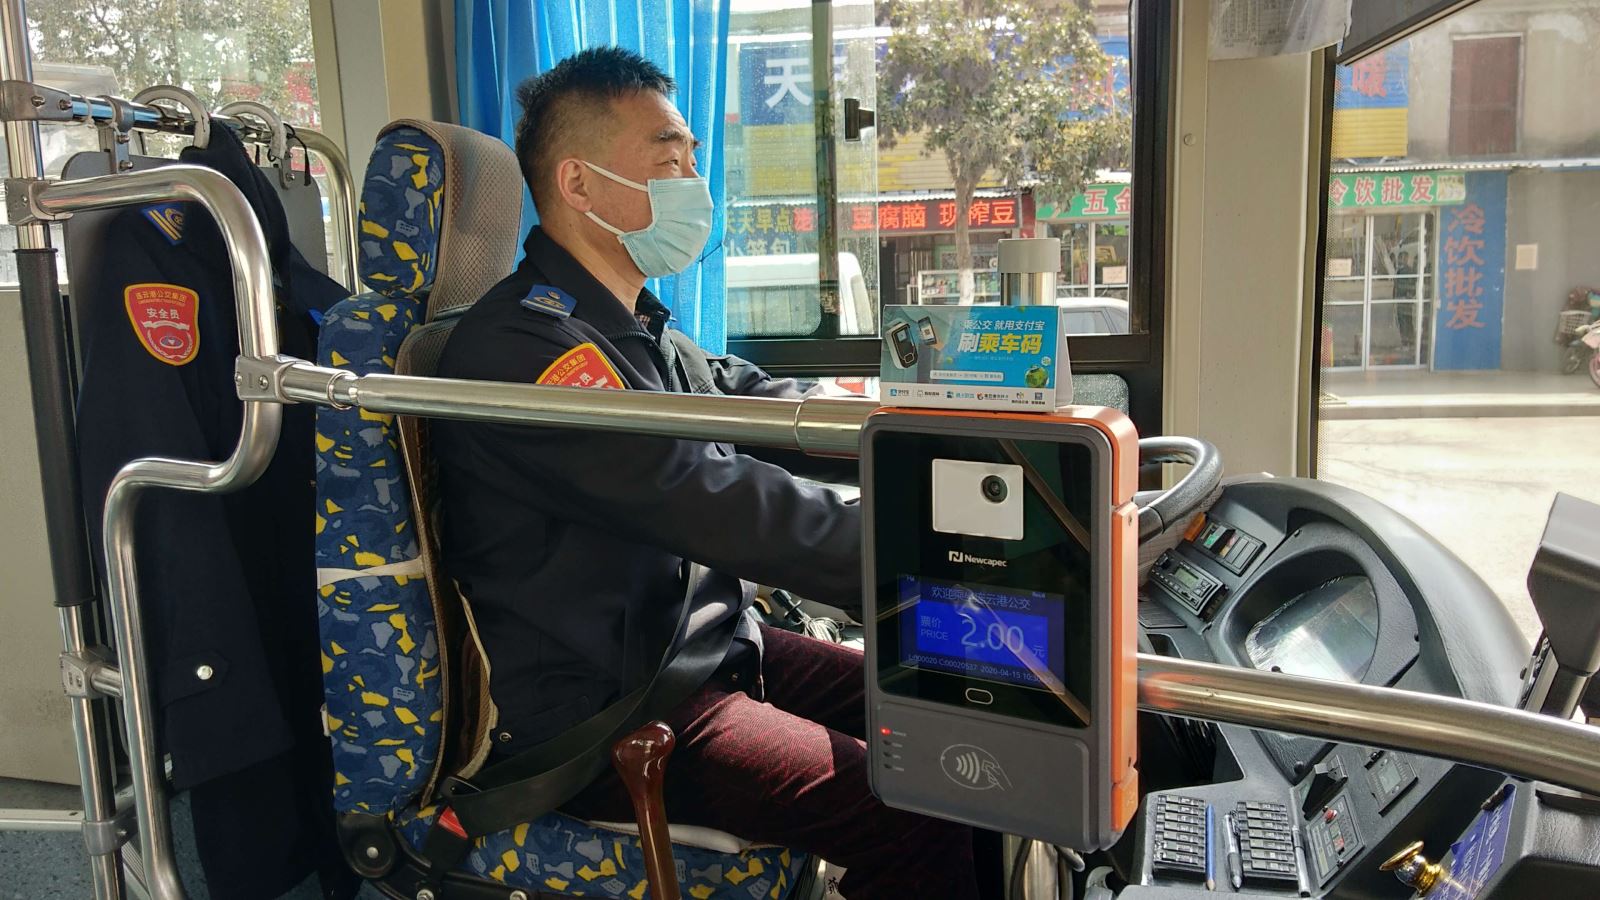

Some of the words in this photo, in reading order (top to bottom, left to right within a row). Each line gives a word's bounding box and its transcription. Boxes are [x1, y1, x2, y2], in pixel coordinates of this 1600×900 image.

[852, 203, 926, 230] 豆腐脑
[1444, 204, 1487, 329] 冷饮批发
[146, 308, 180, 319] 安全员
[994, 320, 1045, 331] 就用支付宝
[957, 333, 1042, 354] 刷乘车码
[965, 554, 1008, 567] Newcapec
[920, 615, 942, 629] 票价
[920, 629, 949, 641] PRICE
[960, 618, 1024, 653] 2.00
[1032, 645, 1045, 657] 元
